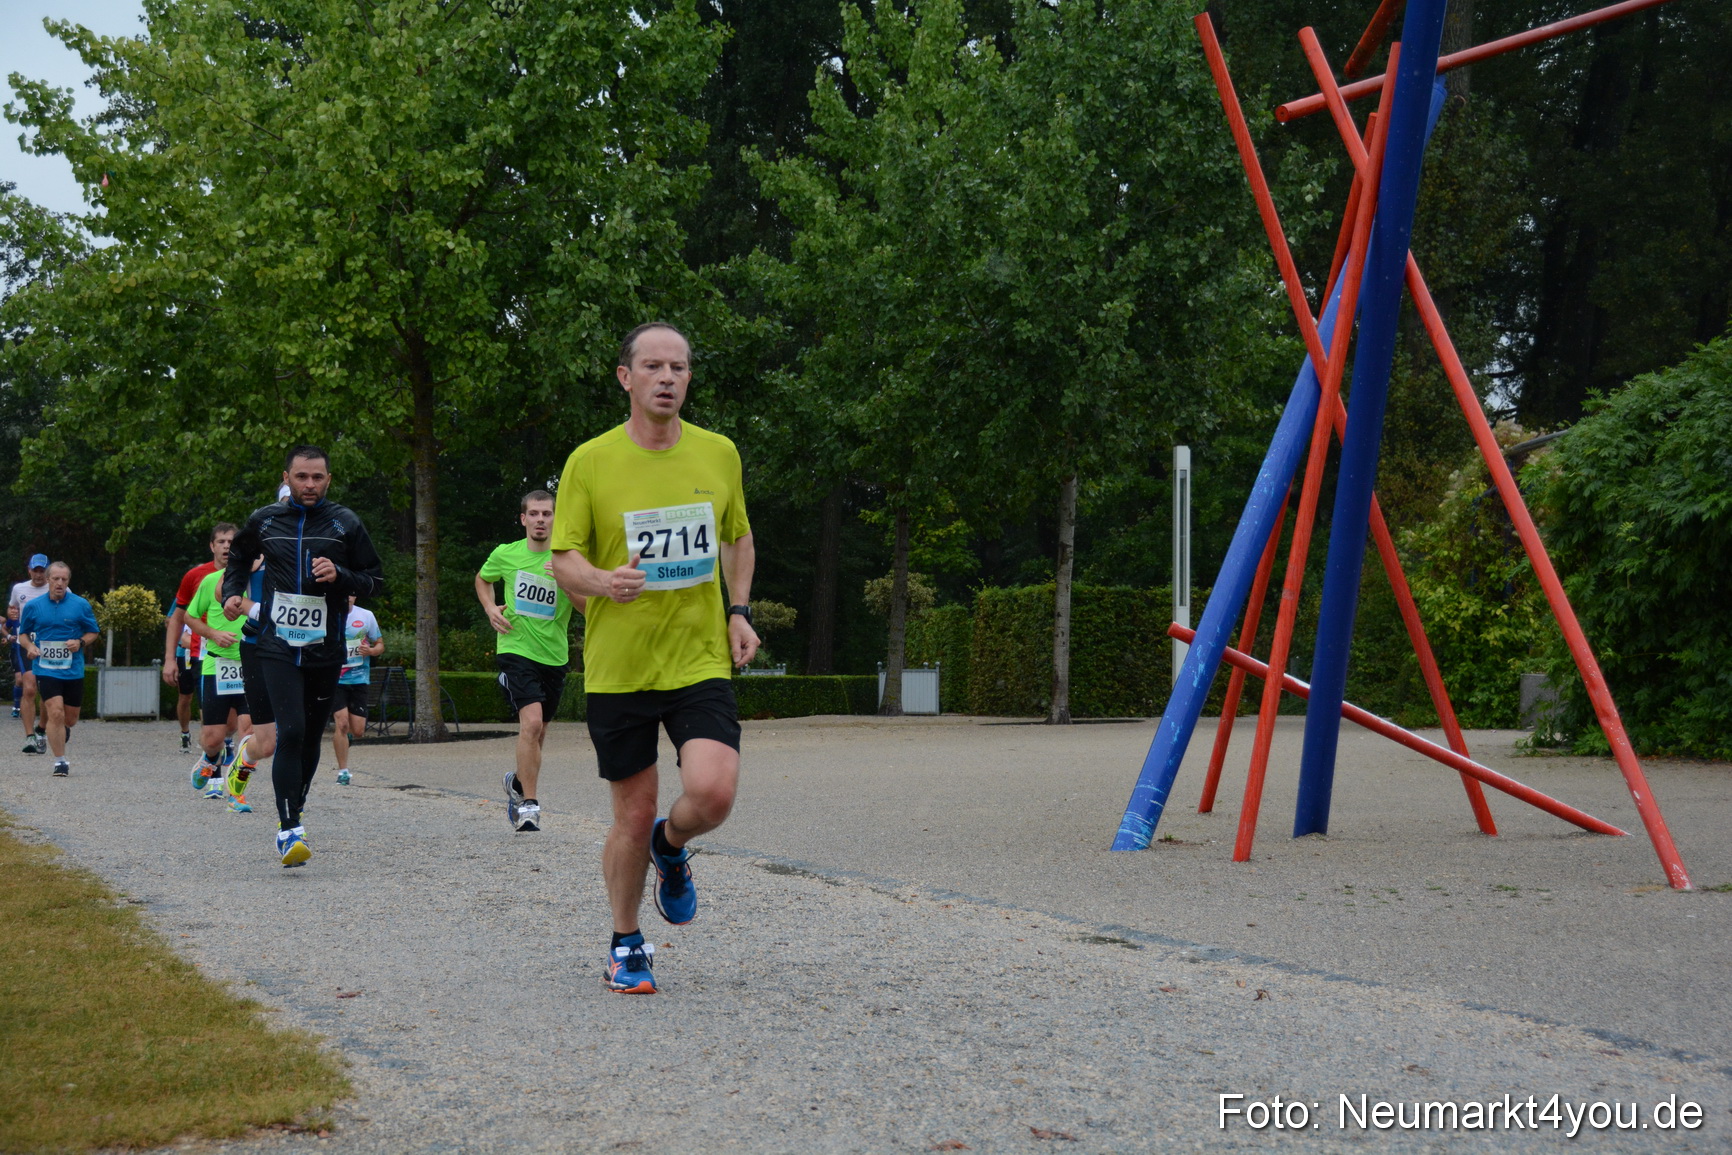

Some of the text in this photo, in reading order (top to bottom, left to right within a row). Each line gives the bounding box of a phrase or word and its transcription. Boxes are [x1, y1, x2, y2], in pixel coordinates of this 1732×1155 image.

[665, 507, 706, 520] BOCK
[637, 524, 709, 559] 2714
[658, 566, 694, 579] Stefan
[517, 582, 556, 605] 2008
[276, 605, 322, 628] 2629
[288, 631, 306, 640] Rico
[43, 647, 70, 659] 2858
